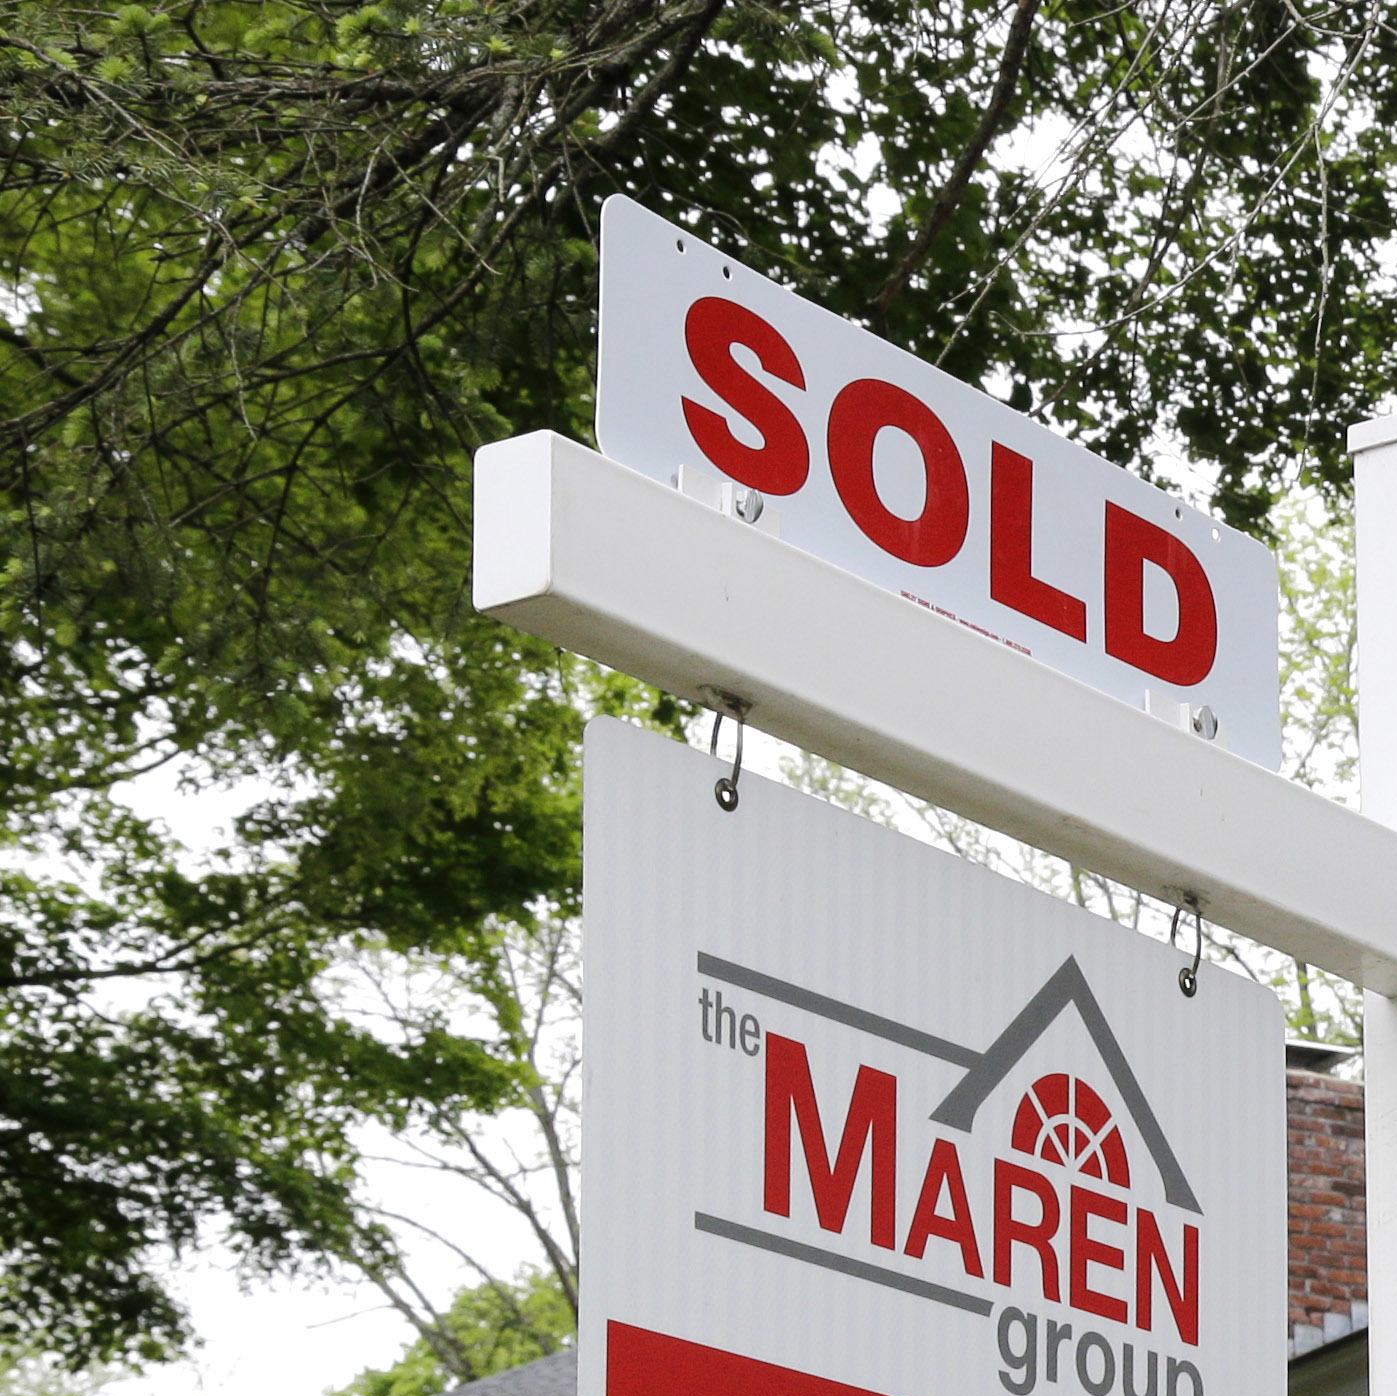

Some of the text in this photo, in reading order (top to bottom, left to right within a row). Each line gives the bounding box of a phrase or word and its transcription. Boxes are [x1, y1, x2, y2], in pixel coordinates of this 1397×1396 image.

[682, 296, 1217, 687] SOLD
[699, 988, 761, 1057] the
[764, 1031, 1200, 1347] MAREN
